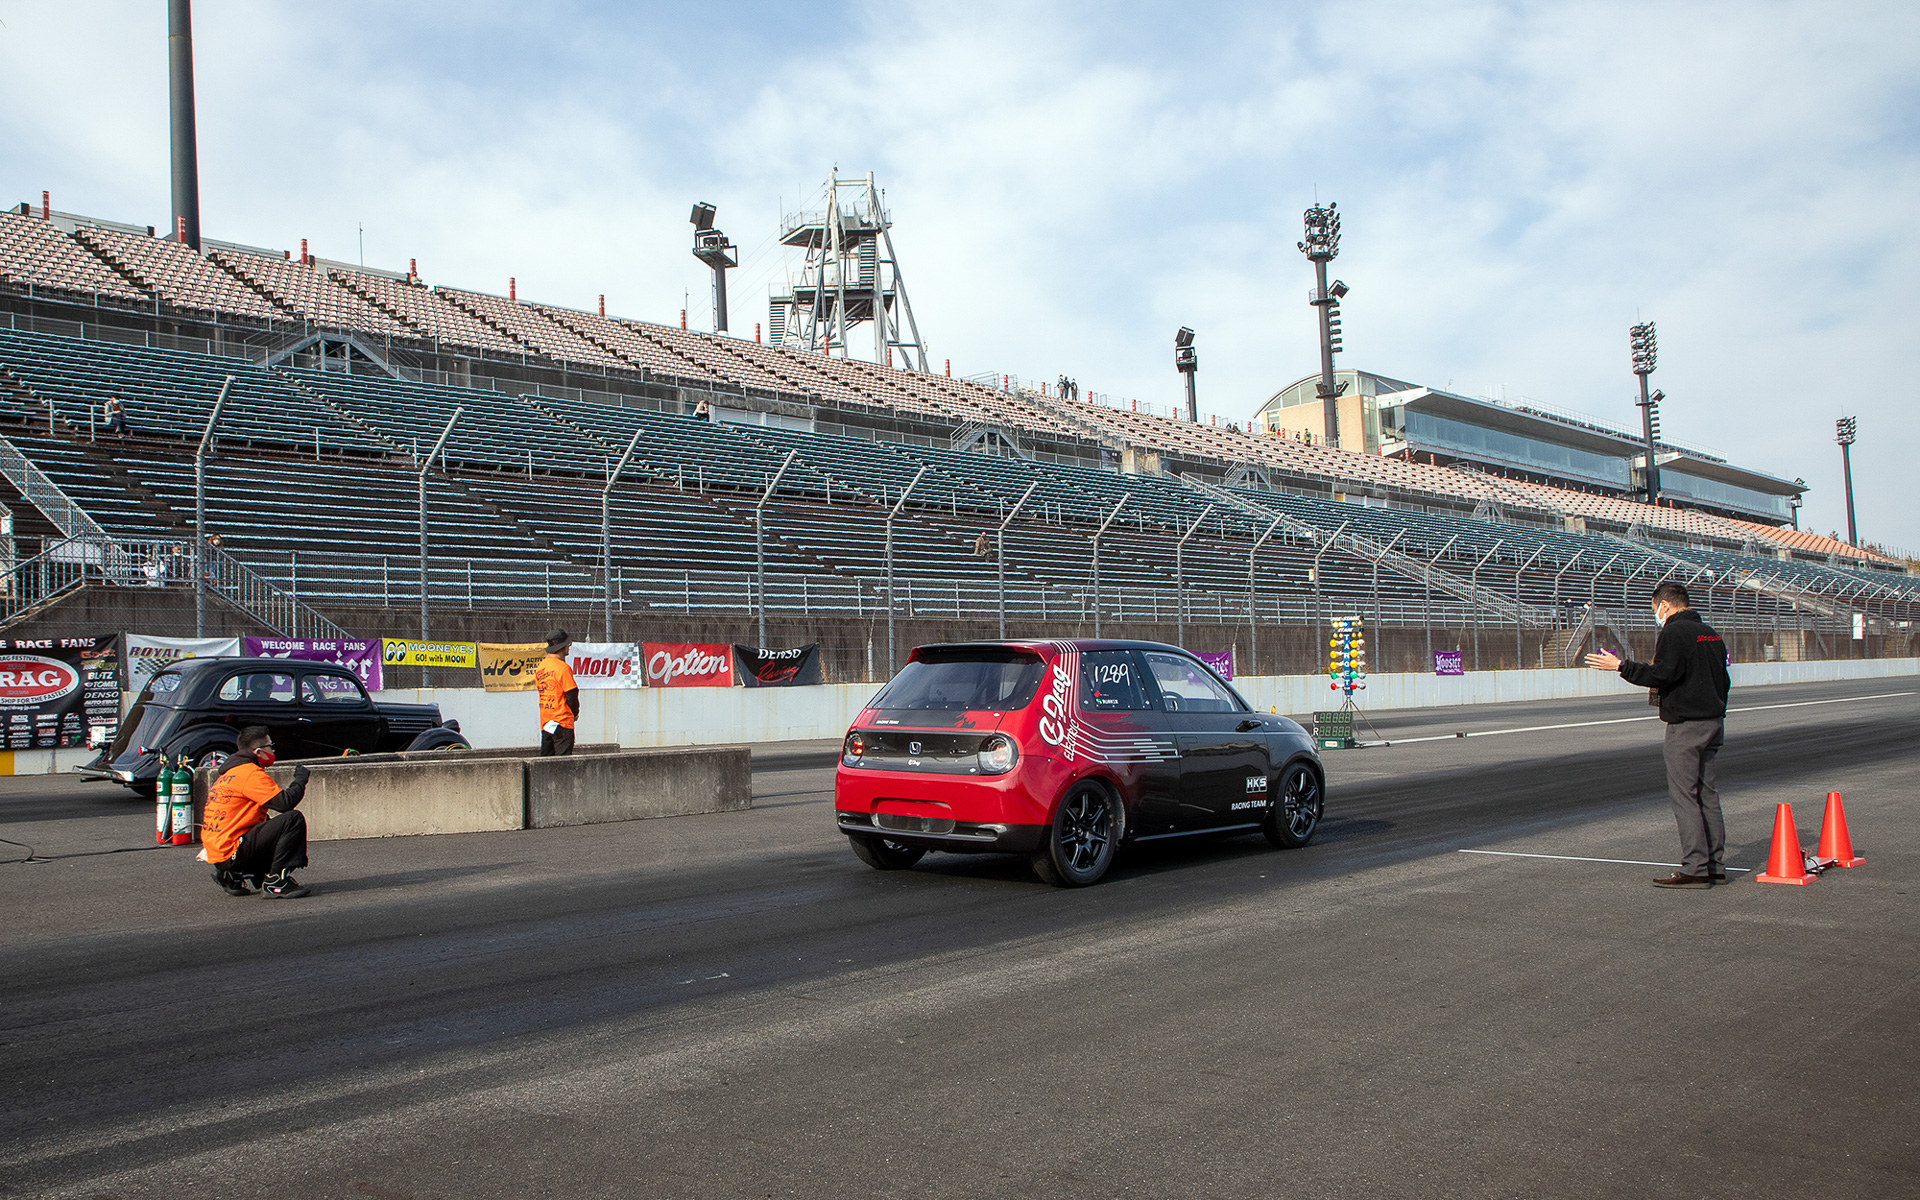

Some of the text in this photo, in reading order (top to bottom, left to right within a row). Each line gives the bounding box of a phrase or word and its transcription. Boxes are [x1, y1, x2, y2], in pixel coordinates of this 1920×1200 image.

[15, 640, 53, 648] RACE
[61, 637, 97, 648] FANS
[261, 640, 366, 651] WELCOME RACE FANS
[408, 642, 474, 654] MOONEYES
[129, 646, 182, 659] ROYAL
[757, 648, 802, 660] DENSO
[415, 653, 466, 664] GO! with MOON
[572, 656, 632, 677] Moty's
[649, 647, 729, 685] Option
[88, 671, 113, 680] BLITZ
[755, 659, 800, 686] Racing
[1094, 663, 1131, 687] 1289
[93, 680, 118, 688] TOMEI
[44, 688, 69, 700] FASTEST
[84, 691, 119, 699] DENSO
[1313, 714, 1319, 723] L
[1313, 727, 1319, 736] R
[1246, 777, 1267, 789] HKS
[1231, 801, 1251, 810] RACING
[1251, 800, 1267, 808] TEAM
